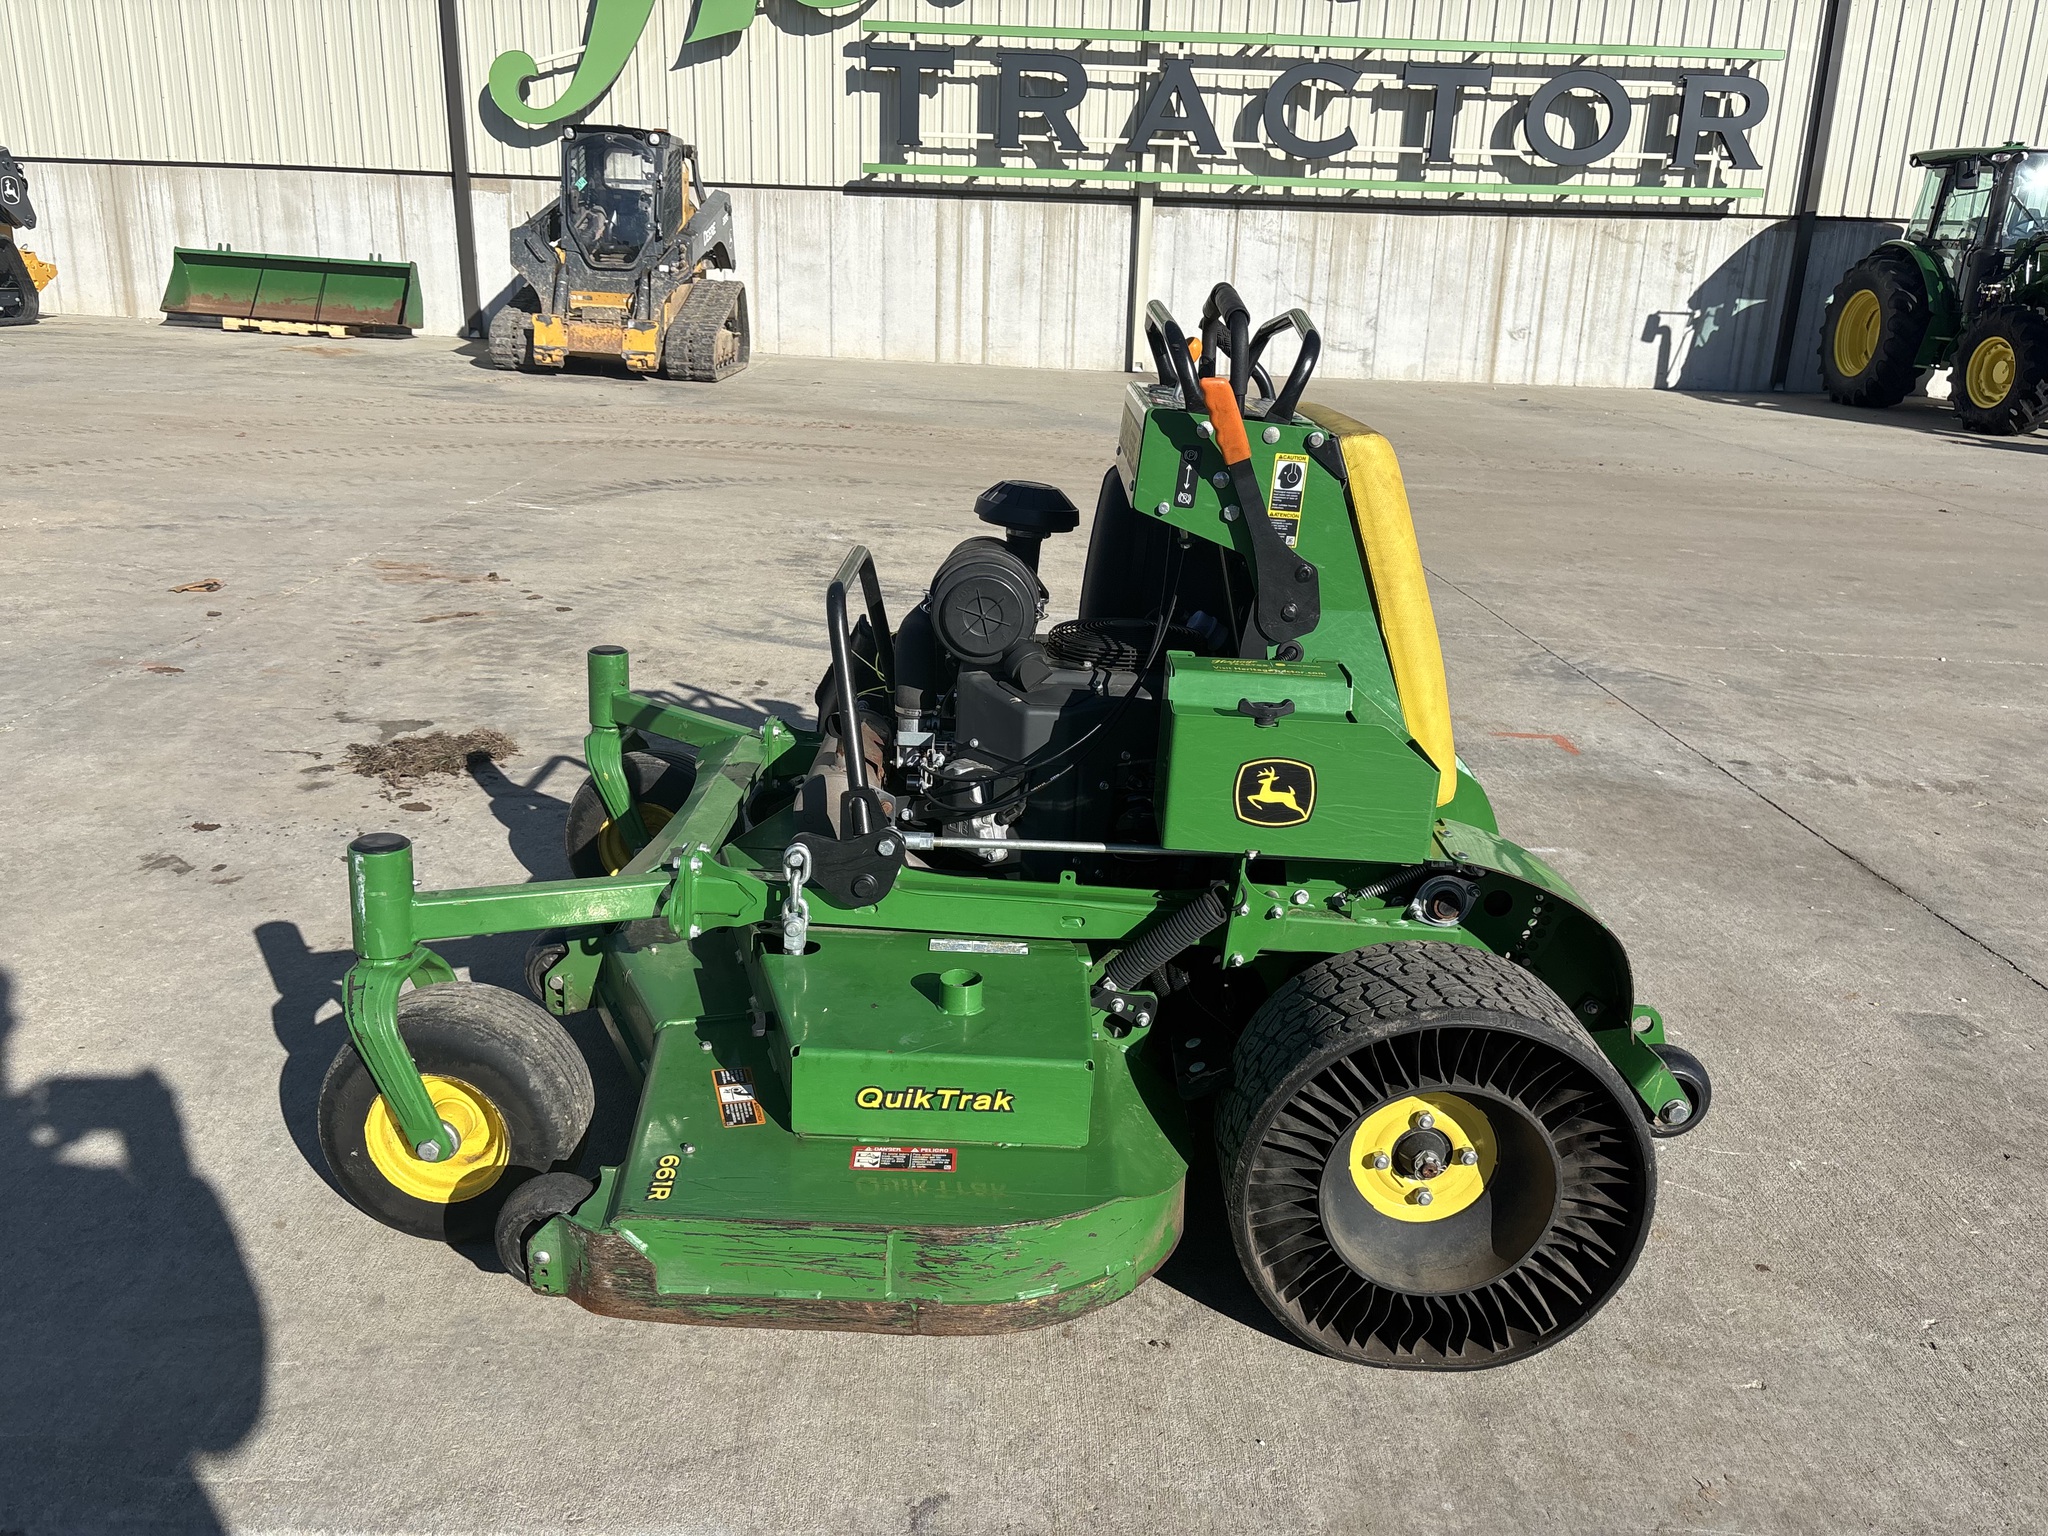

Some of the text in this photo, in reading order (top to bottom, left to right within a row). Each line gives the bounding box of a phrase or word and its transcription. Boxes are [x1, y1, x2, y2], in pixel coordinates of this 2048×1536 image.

[866, 44, 1770, 170] TRACTOR
[856, 1086, 1015, 1112] QuikTrak
[646, 1154, 681, 1201] 661R
